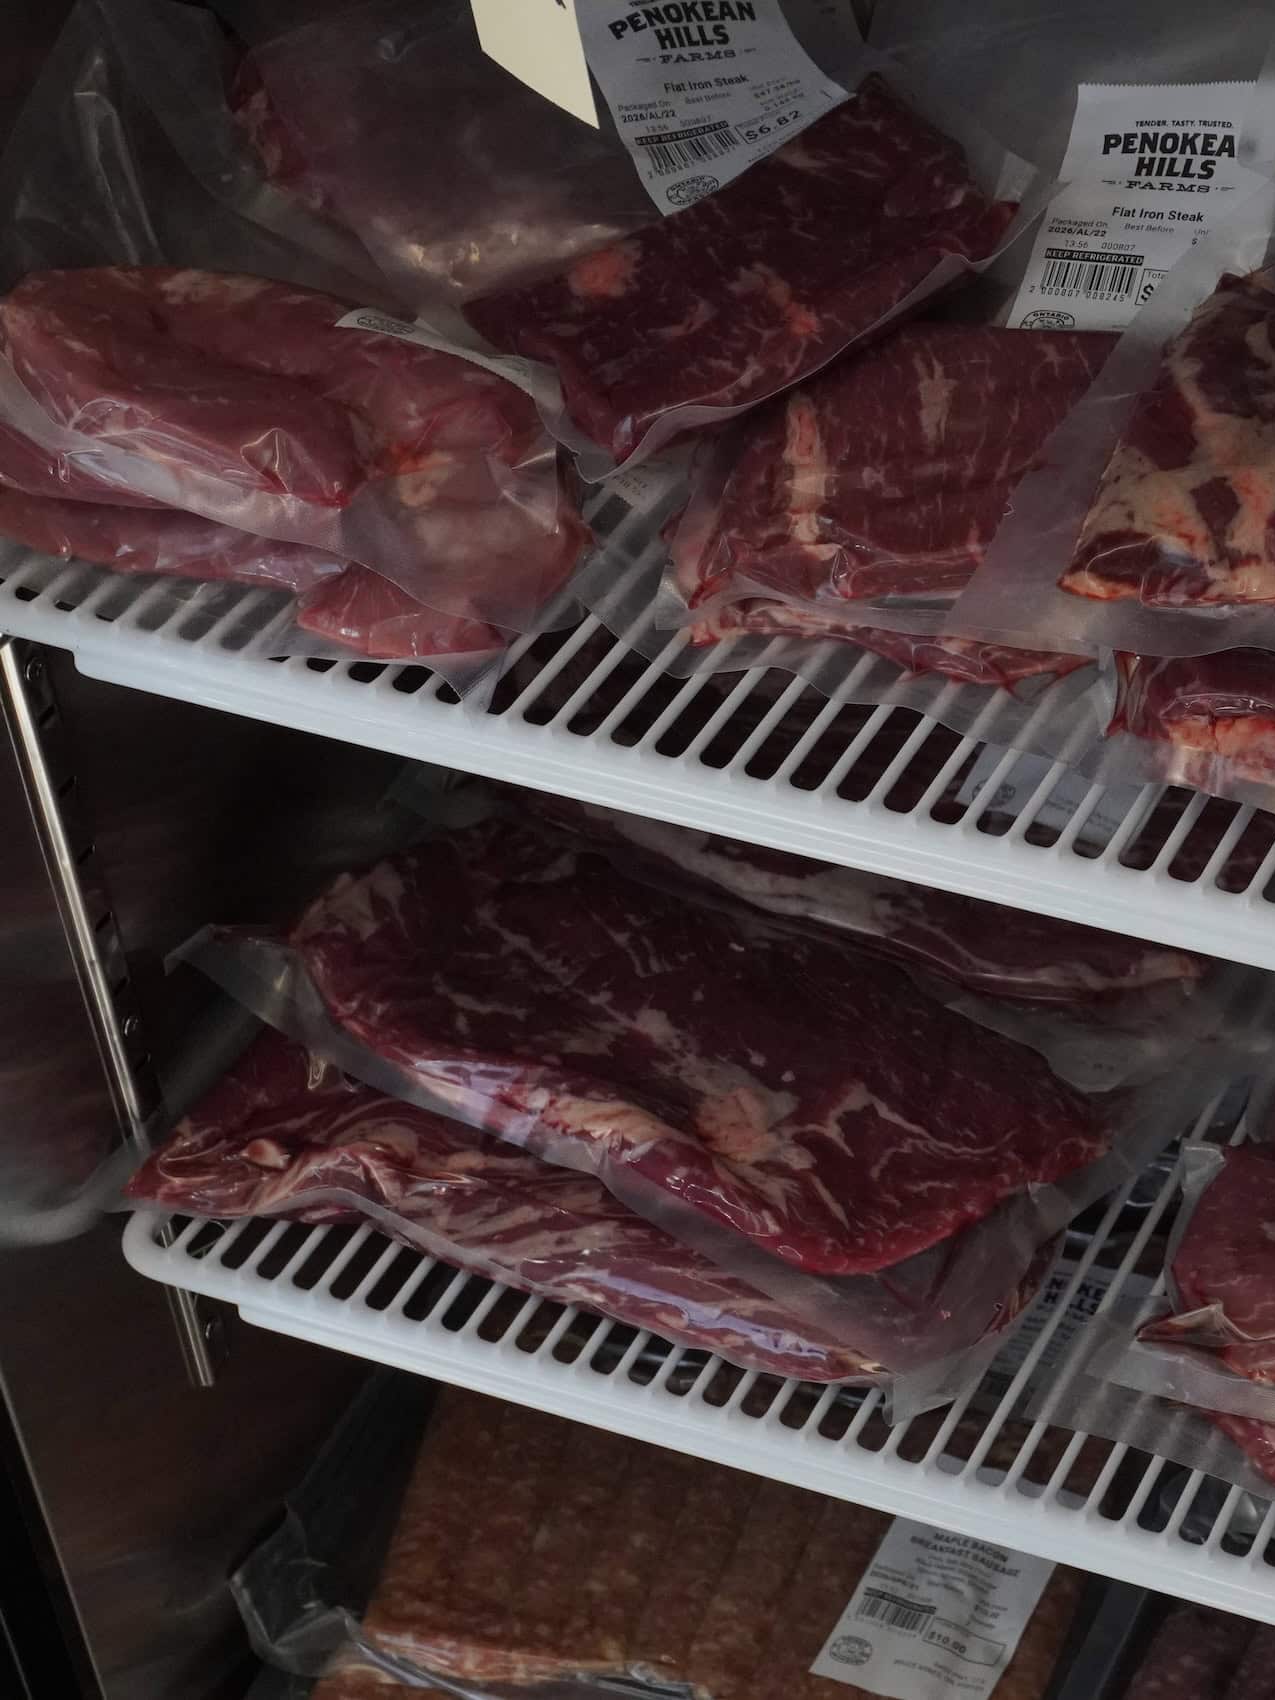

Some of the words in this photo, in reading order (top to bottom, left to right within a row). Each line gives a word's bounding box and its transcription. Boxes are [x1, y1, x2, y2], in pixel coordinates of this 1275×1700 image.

[608, 0, 757, 40] PENOKEAN
[654, 24, 730, 49] HILLS
[659, 50, 736, 64] FARMS
[664, 82, 687, 94] Flat
[689, 79, 713, 91] Iron
[714, 74, 750, 88] Steak
[745, 109, 801, 141] $6.82
[1135, 120, 1168, 128] TENDER.
[1198, 120, 1234, 129] TRUSTED.
[1102, 132, 1236, 158] PENOKEA
[1134, 156, 1217, 180] HILLS
[1125, 180, 1210, 194] FARMS
[1112, 206, 1136, 219] Flat
[1139, 208, 1164, 220] Iron
[1168, 210, 1204, 223] Steak
[1047, 226, 1107, 238] 2026/AL/22
[1046, 249, 1071, 260] KEEP
[1072, 251, 1143, 266] REFRIGERATED
[1032, 312, 1070, 321] ONTARIO
[933, 1532, 969, 1548] MAPLE
[969, 1540, 1009, 1562] BACON
